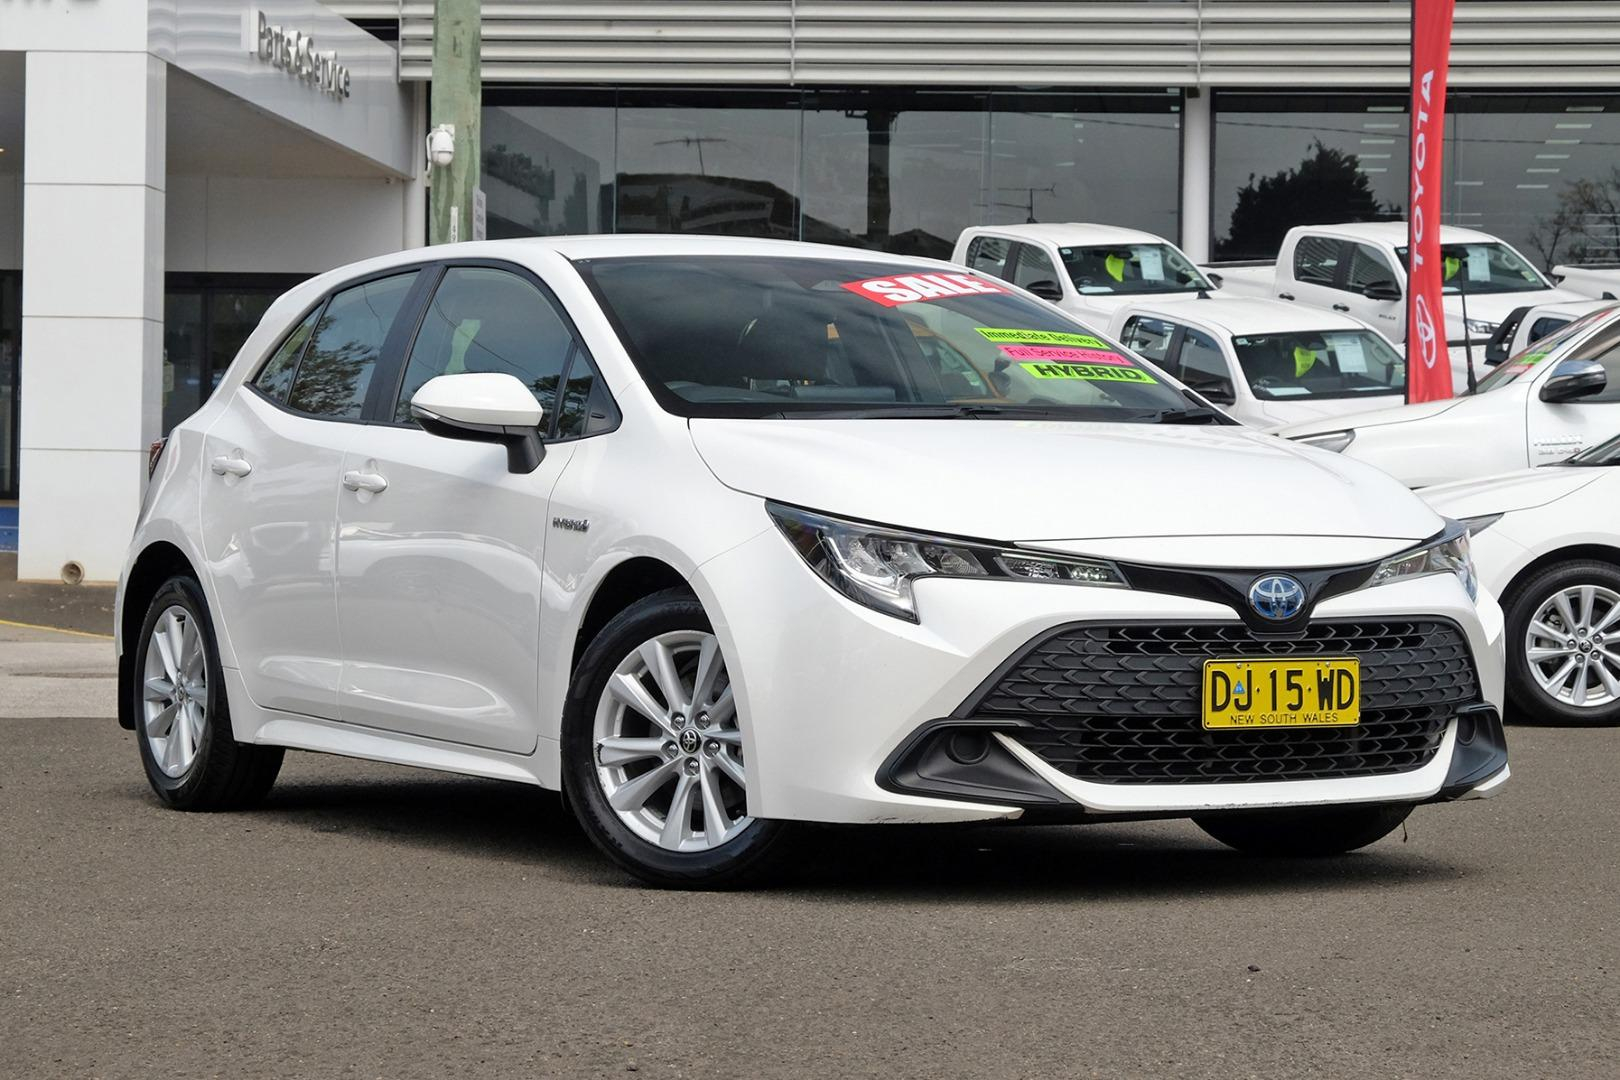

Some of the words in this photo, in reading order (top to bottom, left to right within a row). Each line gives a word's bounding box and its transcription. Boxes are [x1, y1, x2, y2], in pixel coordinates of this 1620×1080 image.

[1413, 69, 1434, 272] TOYOTA
[861, 274, 1001, 302] SALE
[980, 329, 1047, 341] Immediate
[1004, 347, 1032, 356] Full
[1031, 347, 1080, 359] Service
[1033, 364, 1142, 381] HYBRID
[1211, 669, 1253, 712] DJ
[1269, 669, 1304, 712] 15
[1316, 668, 1355, 711] WD
[1230, 714, 1254, 725] NEW
[1259, 713, 1297, 724] SOUTH
[1303, 712, 1339, 723] WALES
